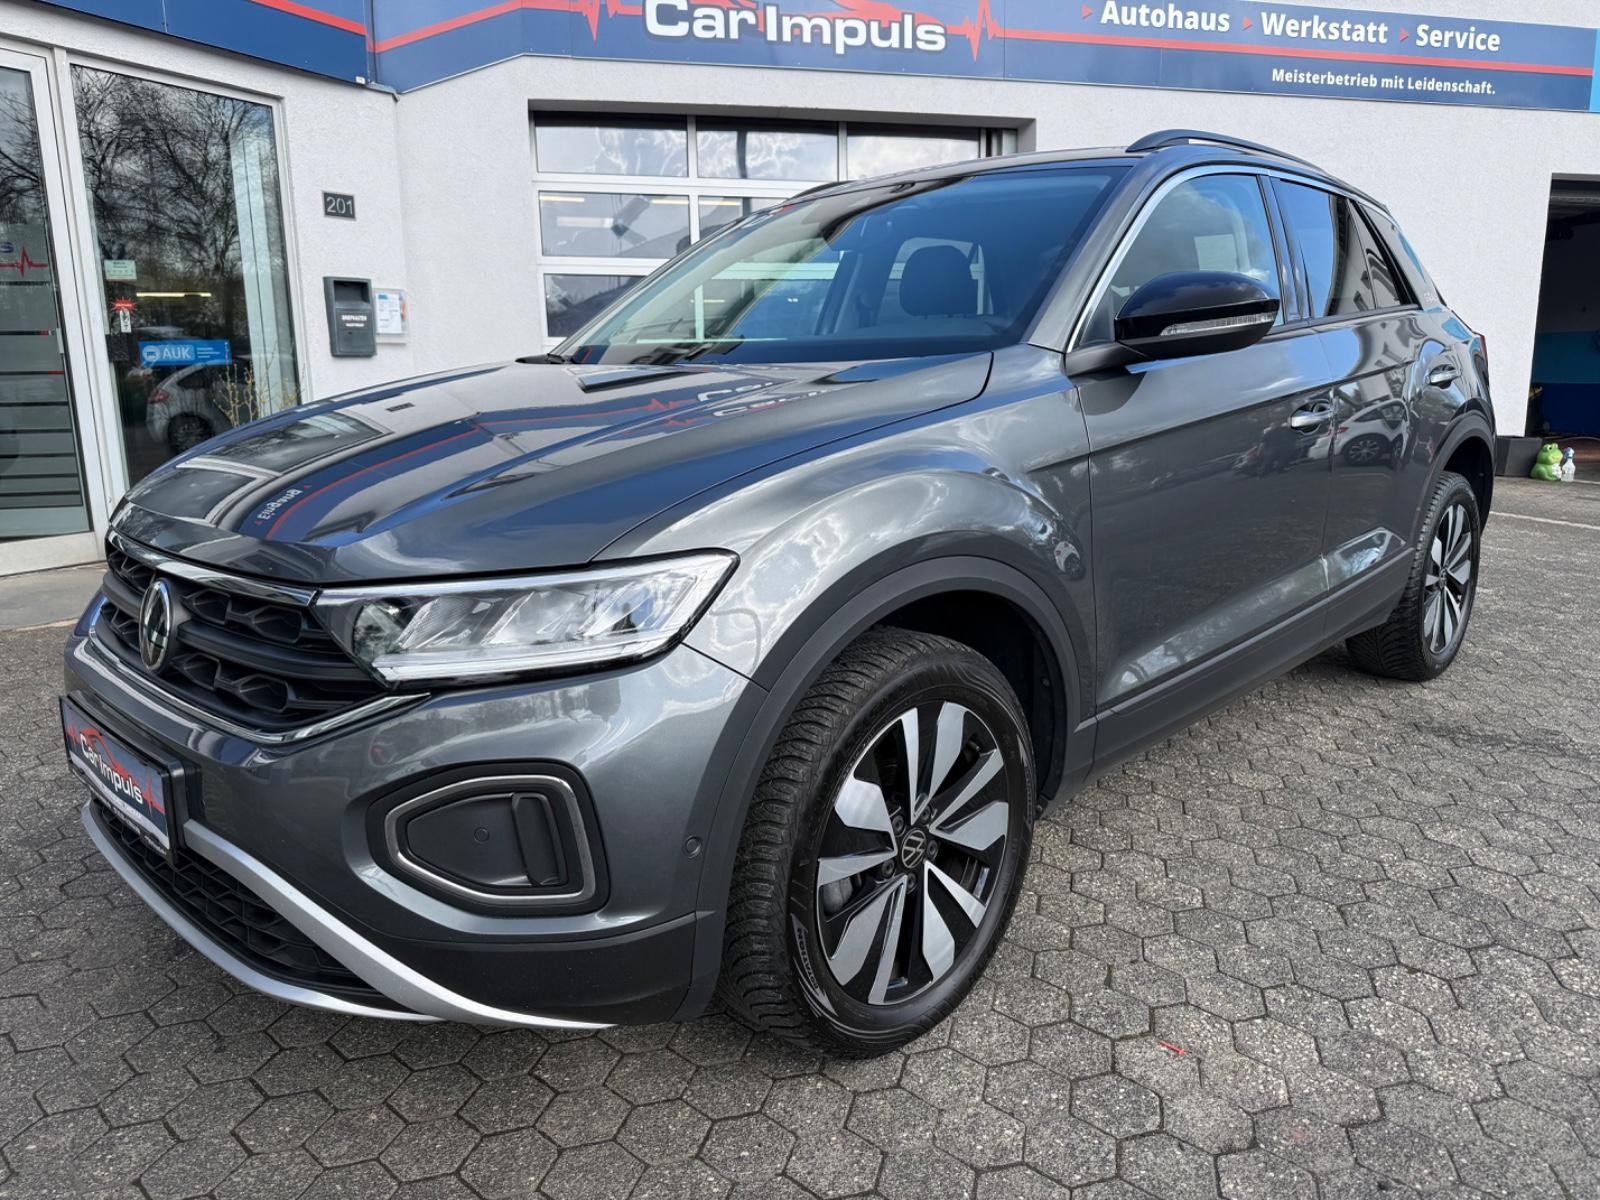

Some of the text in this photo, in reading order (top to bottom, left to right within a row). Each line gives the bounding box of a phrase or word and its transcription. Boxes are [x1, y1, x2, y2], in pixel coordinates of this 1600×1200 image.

[1100, 0, 1500, 51] Autohaus Werkstatt Service
[1272, 68, 1496, 95] Meisterbetrieb mit Leidenschaft.
[326, 196, 353, 215] 201
[162, 345, 191, 359] AUK
